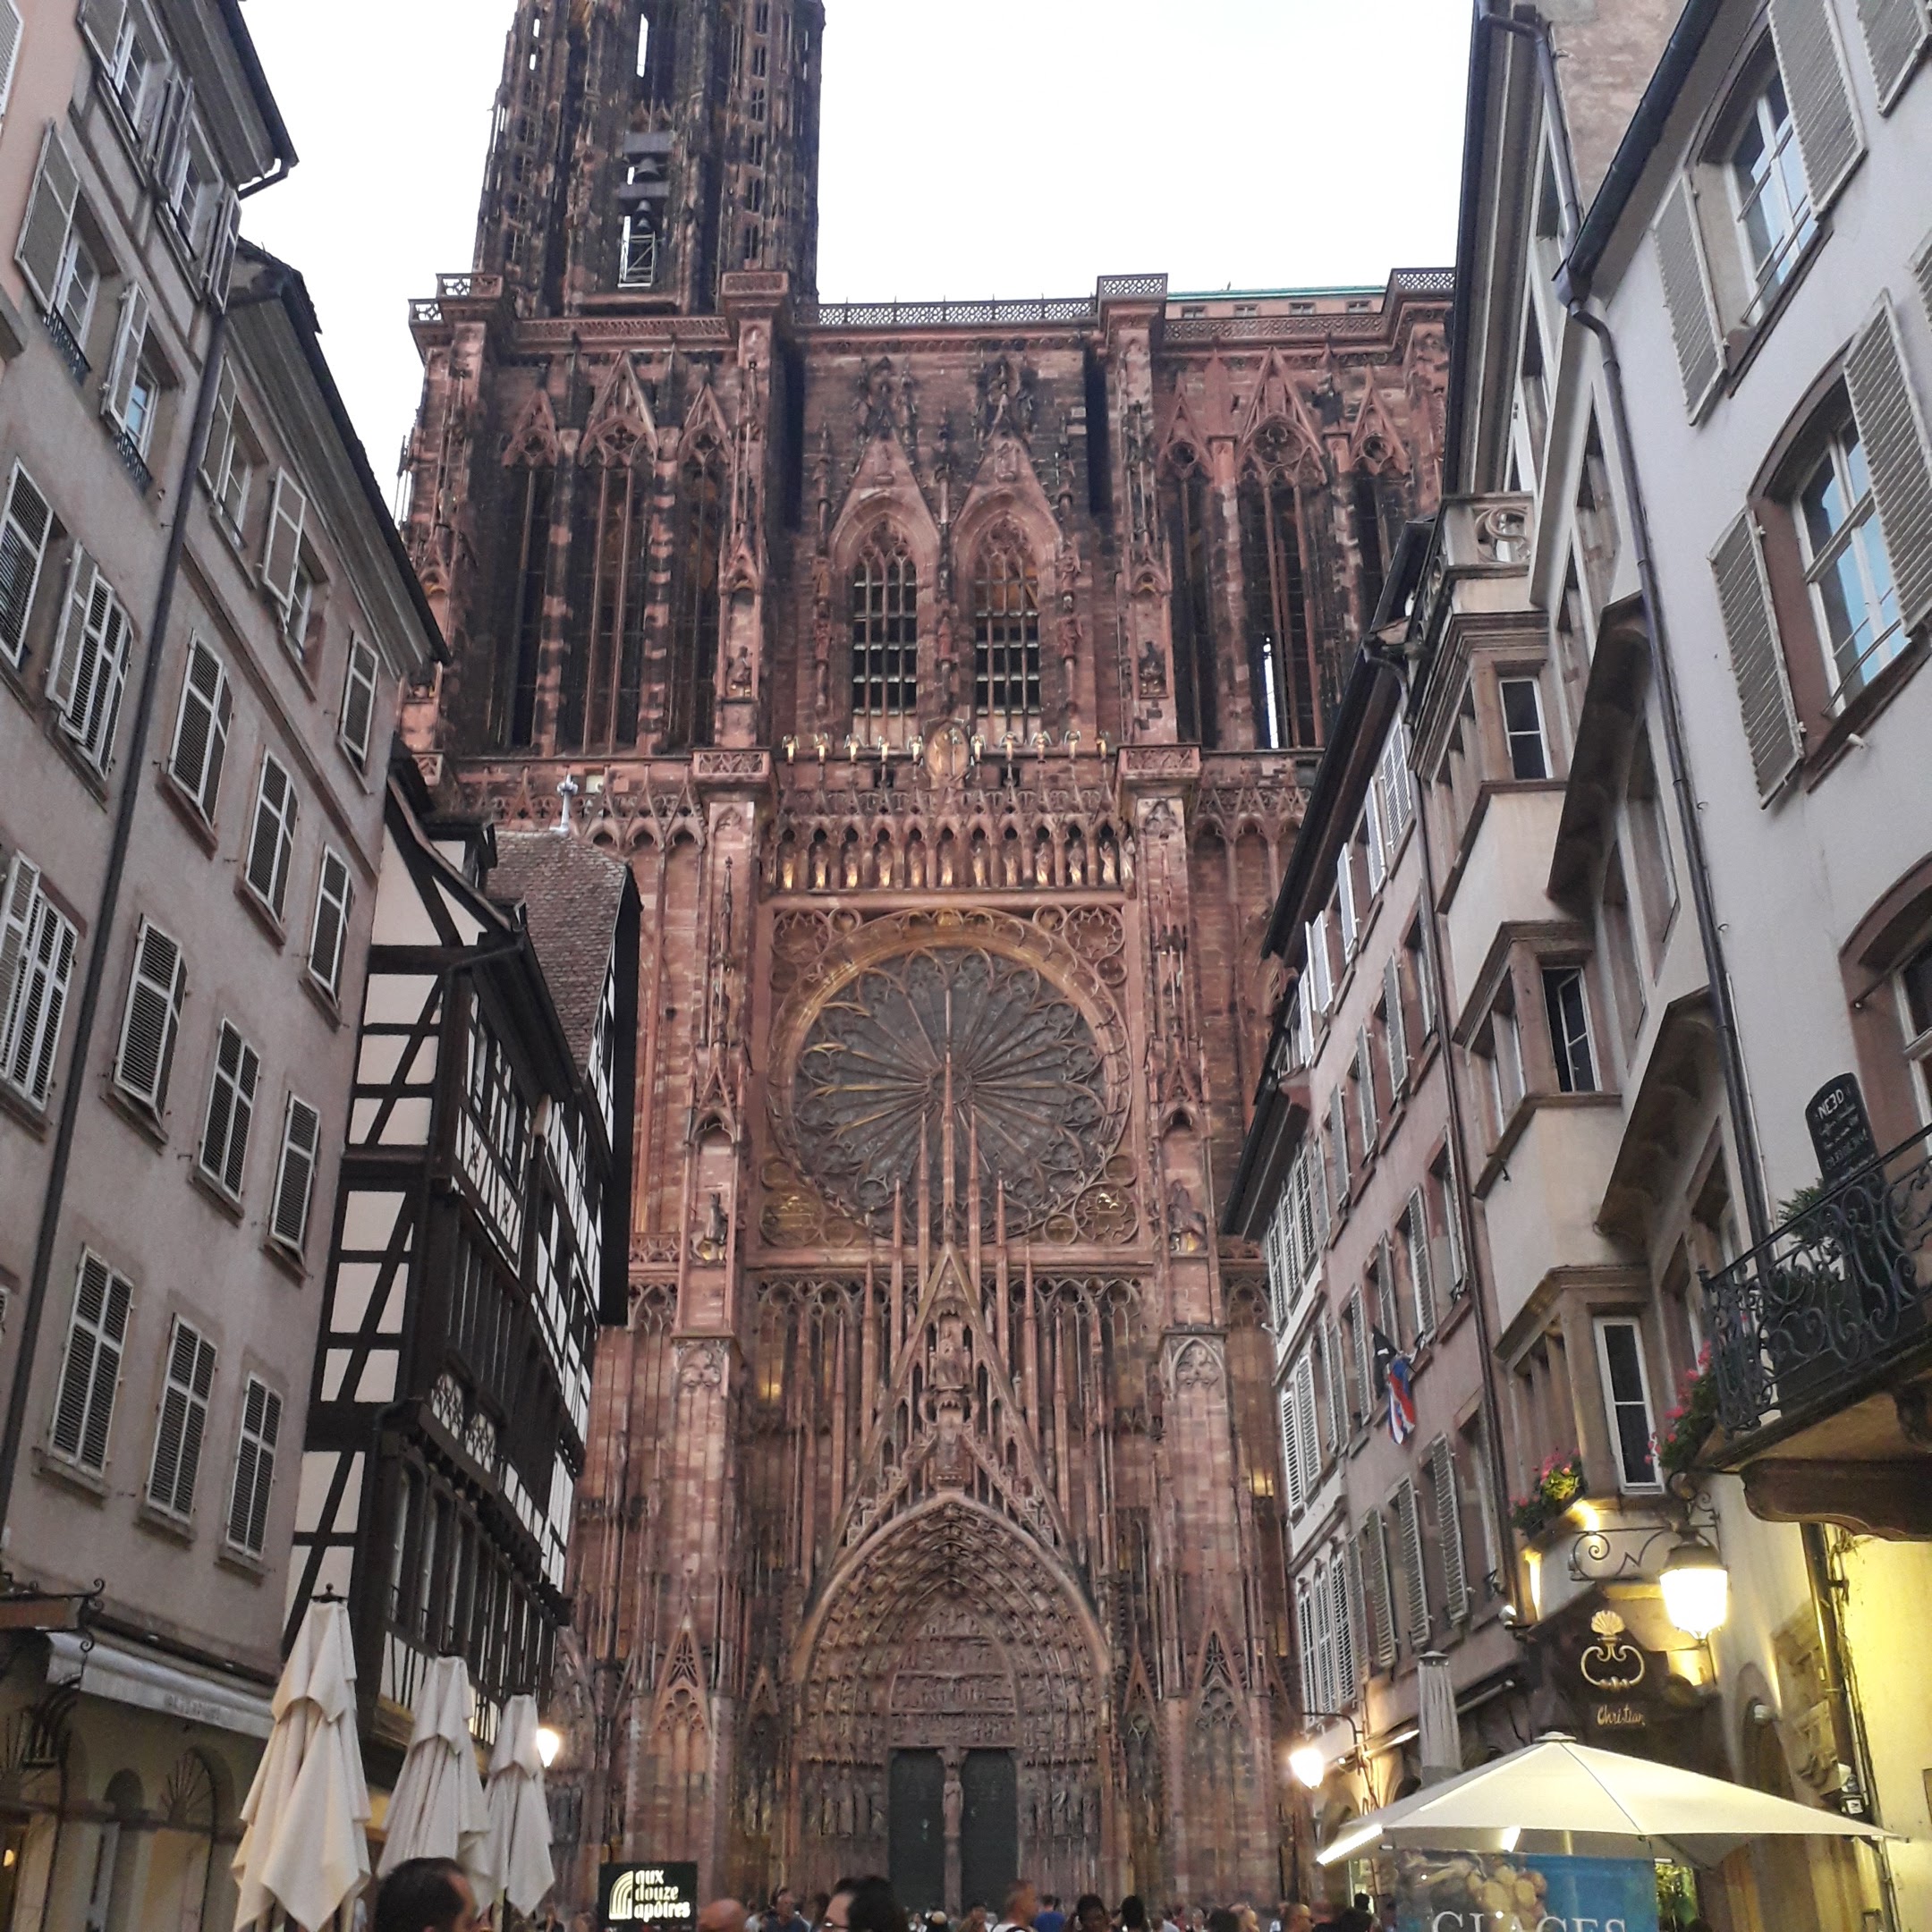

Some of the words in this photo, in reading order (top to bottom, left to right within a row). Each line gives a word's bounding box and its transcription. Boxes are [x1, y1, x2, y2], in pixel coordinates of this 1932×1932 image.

[635, 1869, 665, 1885] aux
[635, 1884, 679, 1902] douze
[633, 1901, 691, 1923] apôtres
